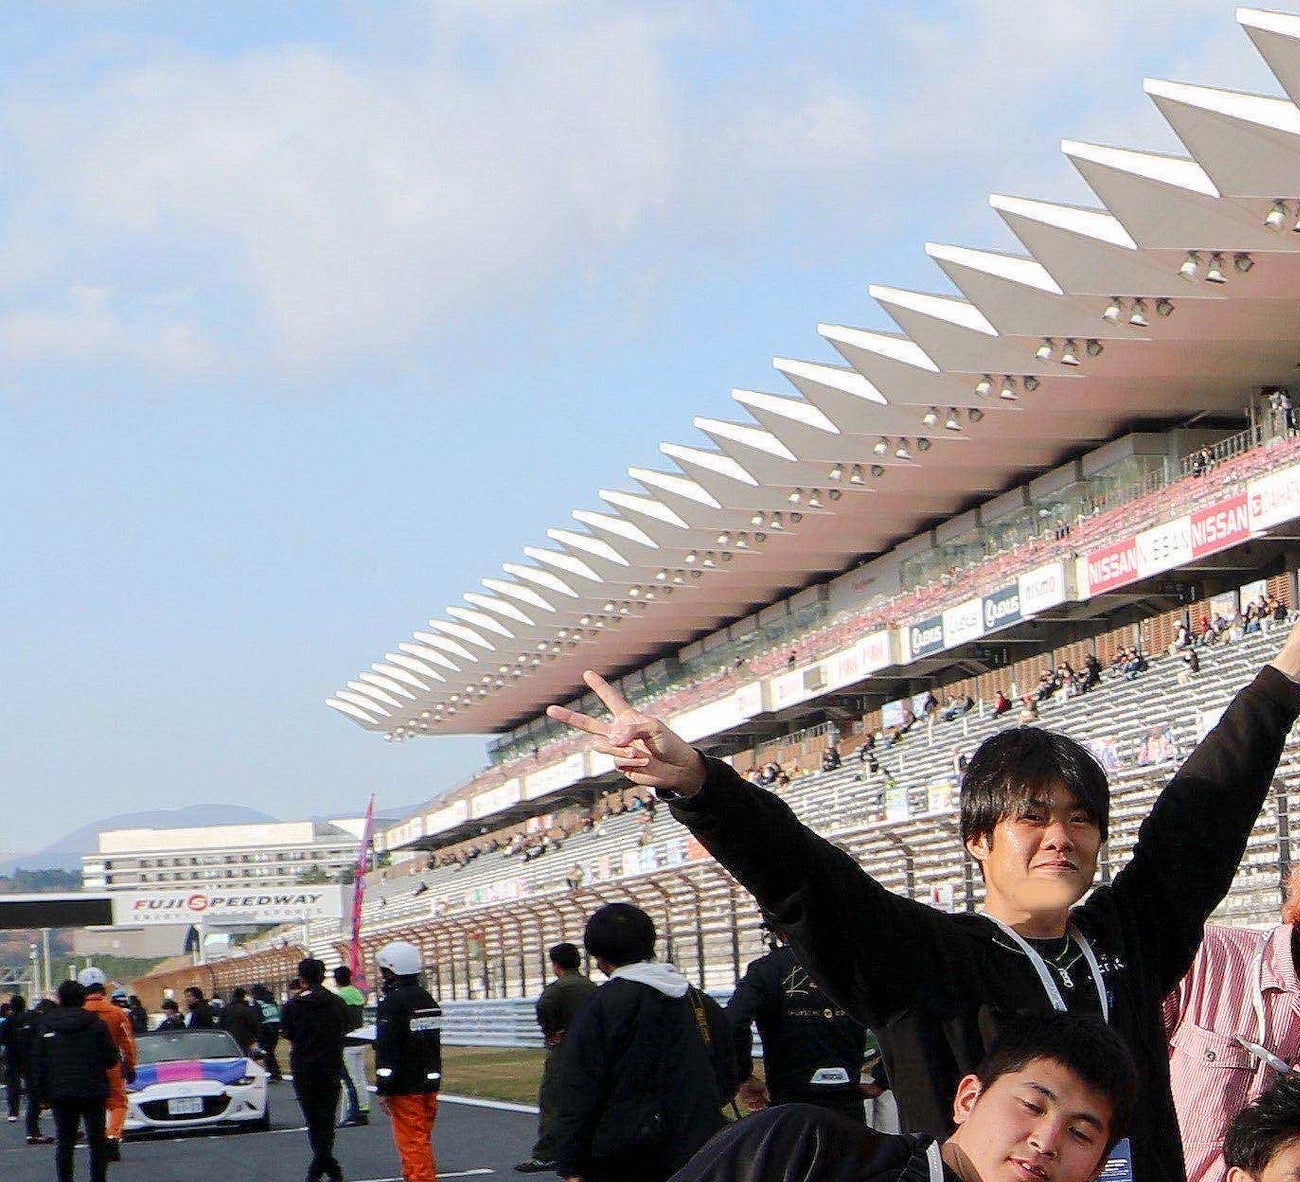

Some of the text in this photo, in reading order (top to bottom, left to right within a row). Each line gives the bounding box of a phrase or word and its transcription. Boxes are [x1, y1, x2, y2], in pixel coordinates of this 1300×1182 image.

[1191, 506, 1249, 546] NISSAN
[1088, 547, 1138, 584] NISSAN
[131, 898, 185, 911] FUJI
